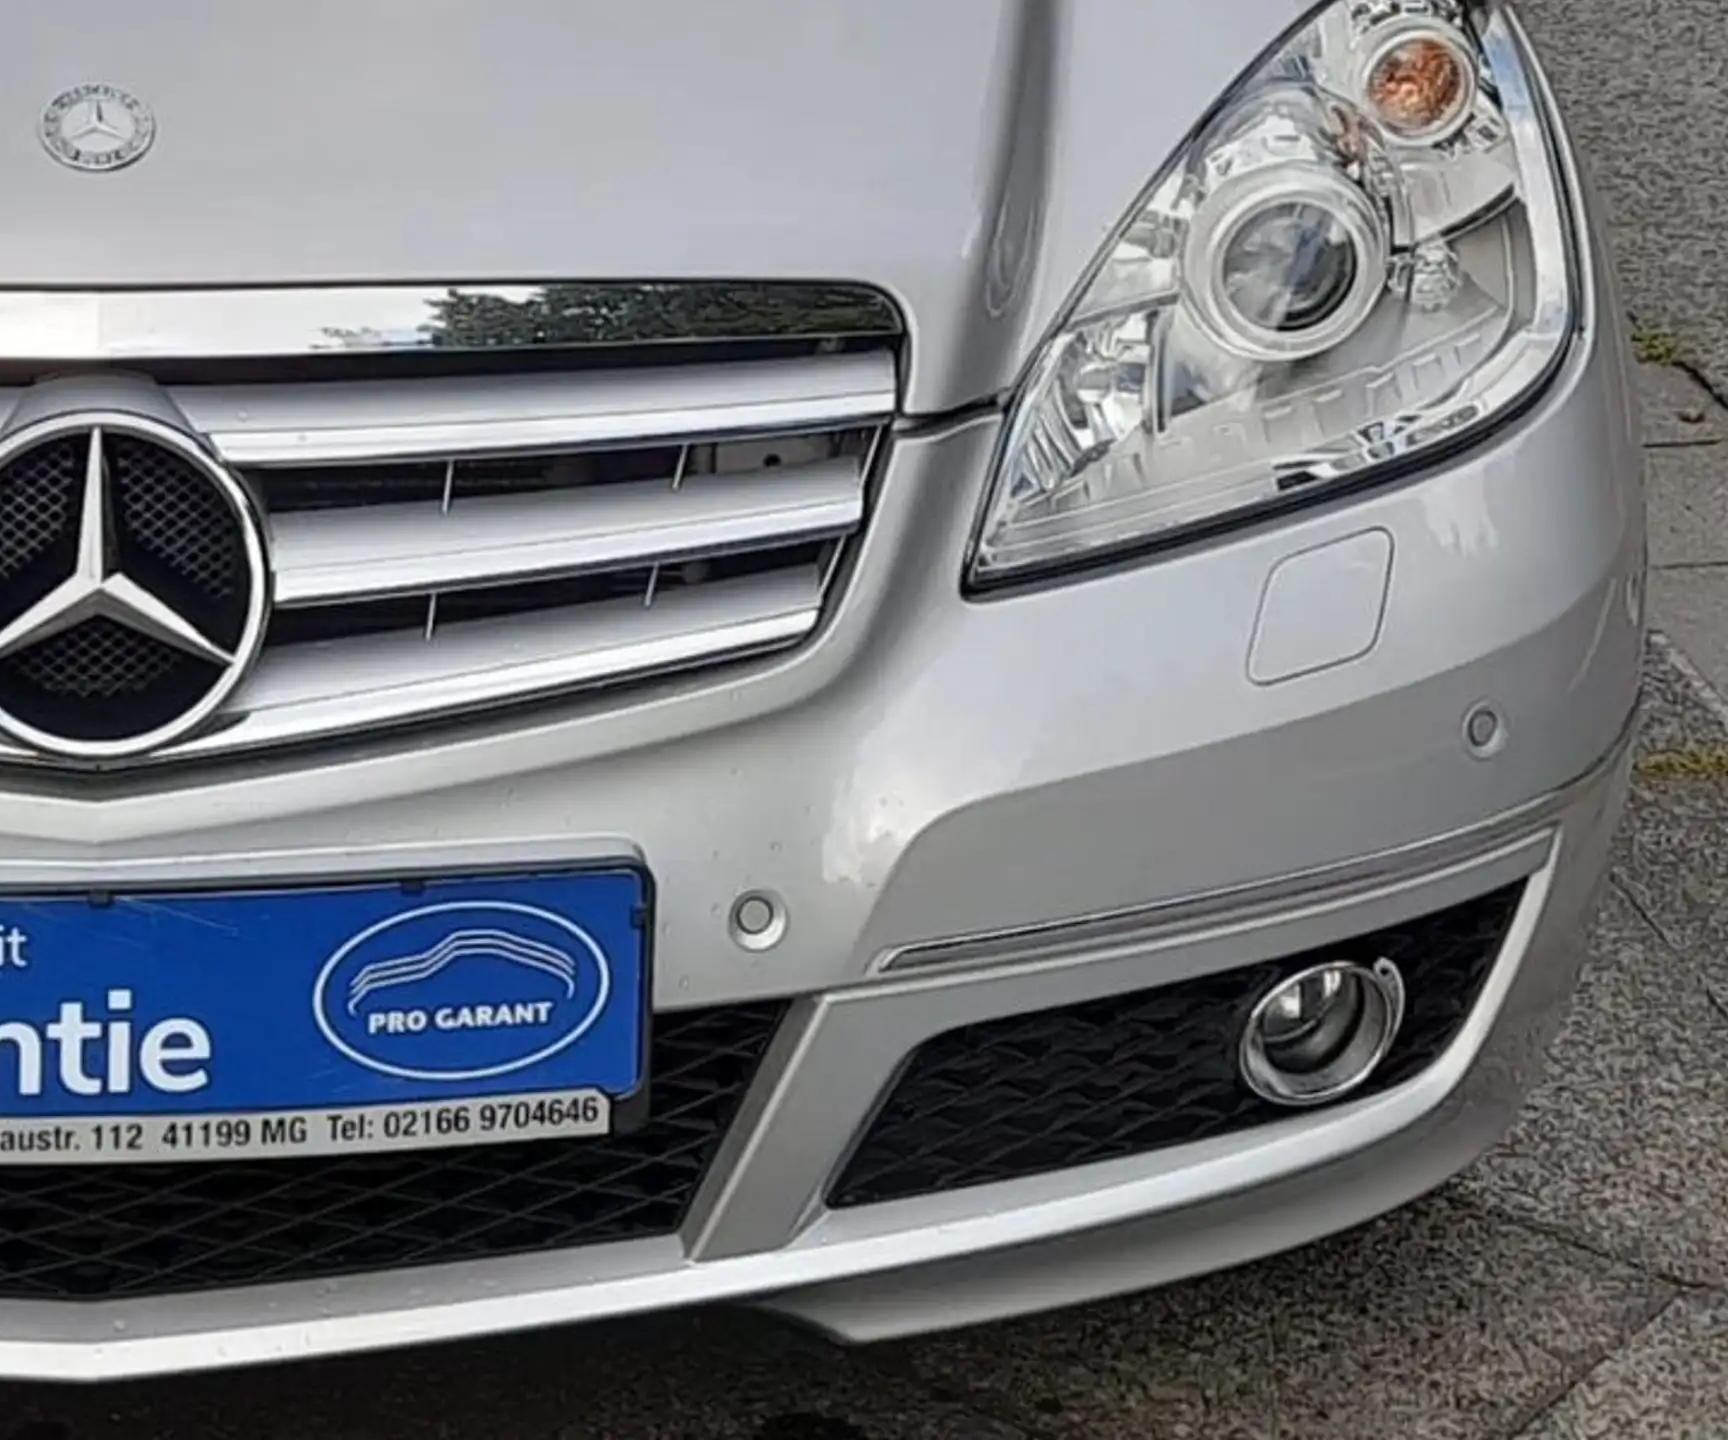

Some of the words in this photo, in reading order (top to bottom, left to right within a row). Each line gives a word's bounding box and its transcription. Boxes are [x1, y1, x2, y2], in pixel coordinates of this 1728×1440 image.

[368, 1011, 427, 1035] PRO
[435, 1002, 553, 1029] GARANT
[92, 1123, 143, 1151] 112
[161, 1119, 251, 1147] 41199
[260, 1116, 307, 1144] MG
[327, 1114, 373, 1141] Tel:
[383, 1106, 470, 1138] 02166
[479, 1096, 599, 1131] 9704646
